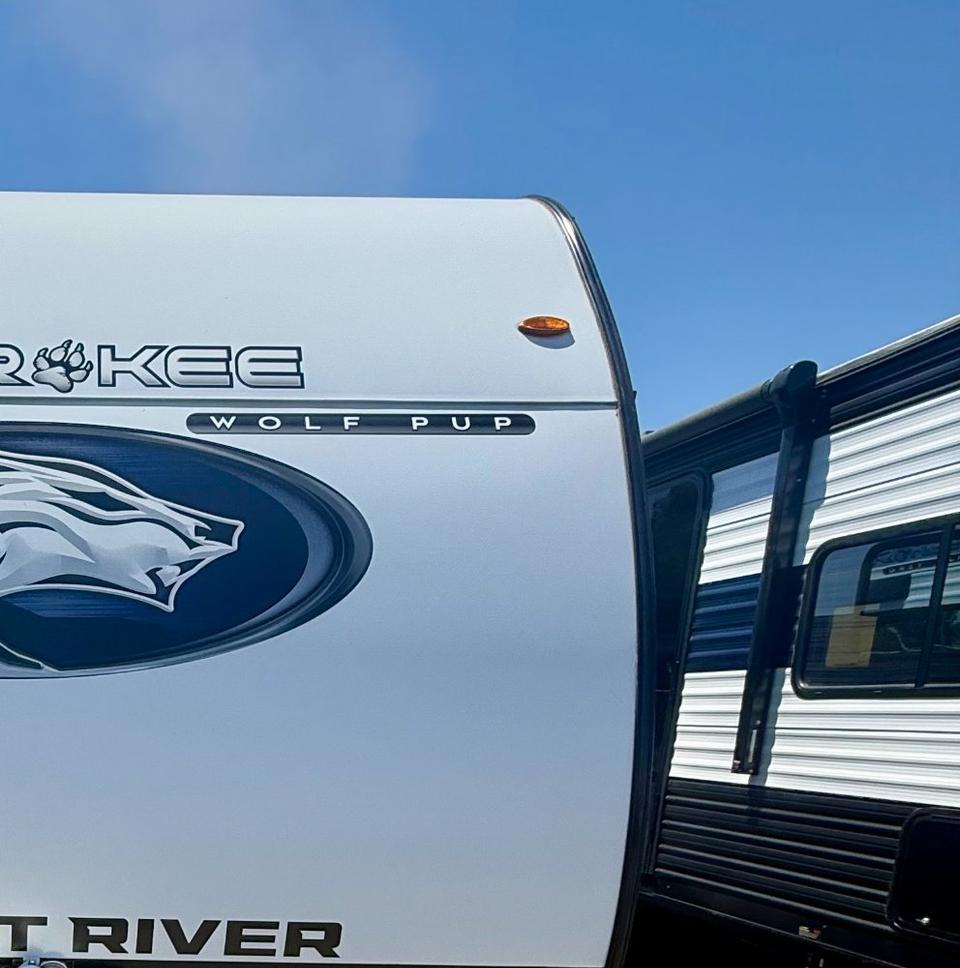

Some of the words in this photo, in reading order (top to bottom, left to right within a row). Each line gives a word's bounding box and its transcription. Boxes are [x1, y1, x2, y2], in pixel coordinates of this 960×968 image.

[209, 416, 360, 431] WOLF
[411, 416, 513, 430] PUP
[67, 917, 343, 958] RIVER
